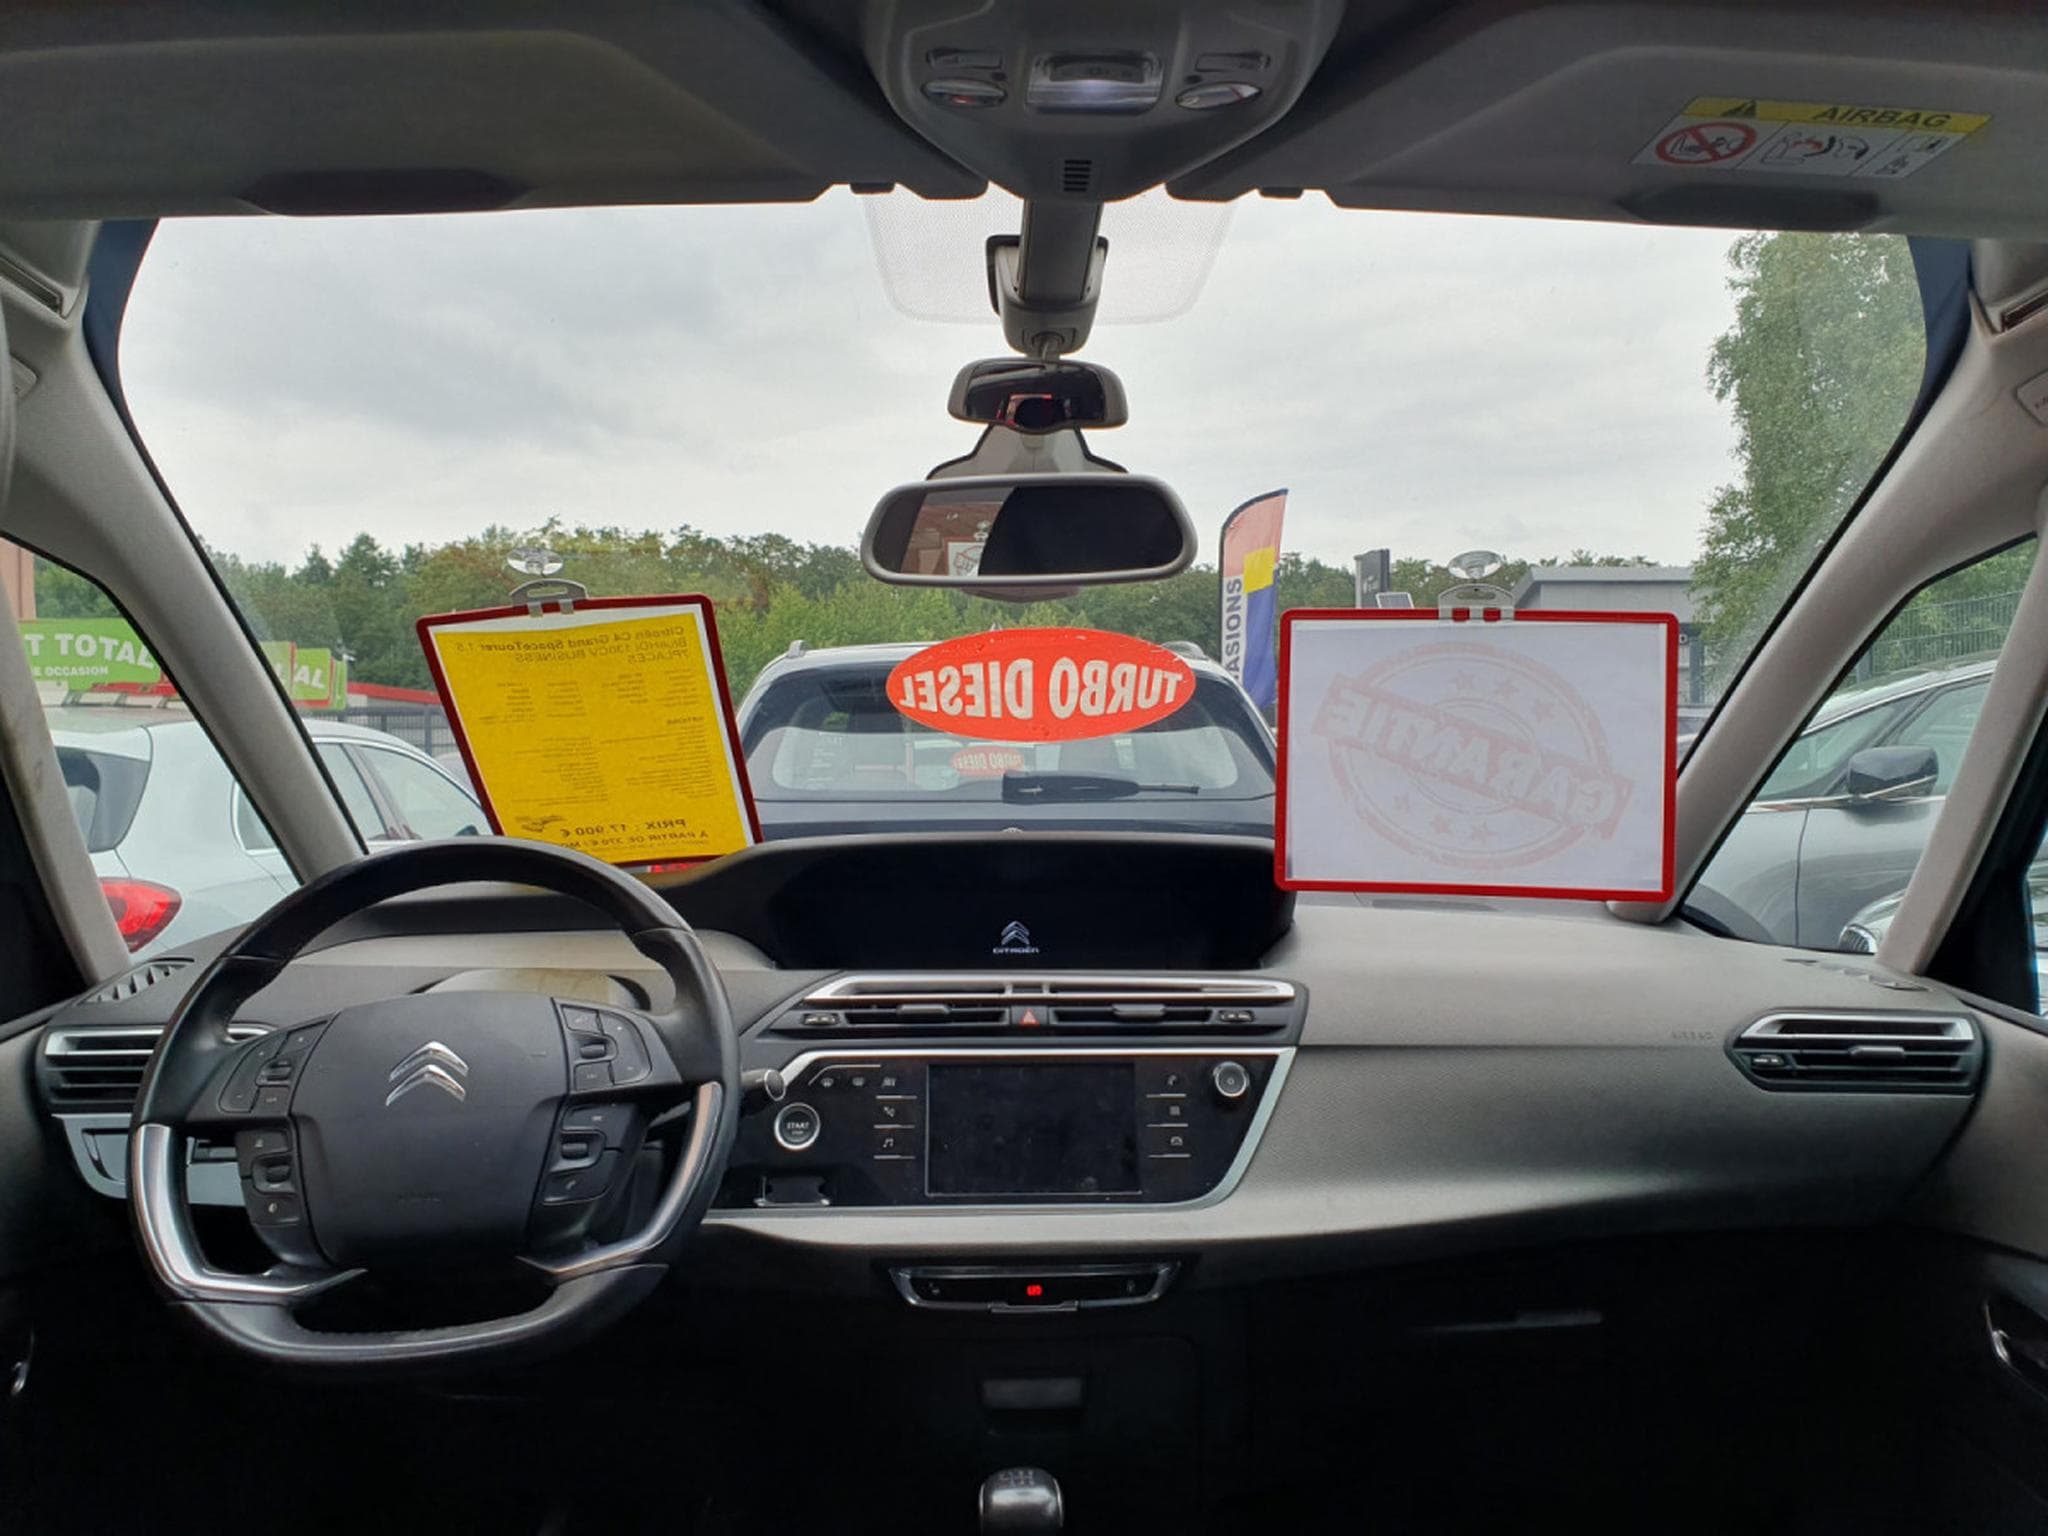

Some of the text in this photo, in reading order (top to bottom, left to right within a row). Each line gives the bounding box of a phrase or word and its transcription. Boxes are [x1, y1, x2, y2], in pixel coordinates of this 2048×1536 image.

[1812, 106, 1952, 128] AIRBAG
[1225, 578, 1243, 681] ASIONS
[54, 632, 155, 669] TOTAL
[45, 665, 109, 677] OCCASION
[786, 1121, 810, 1130] START
